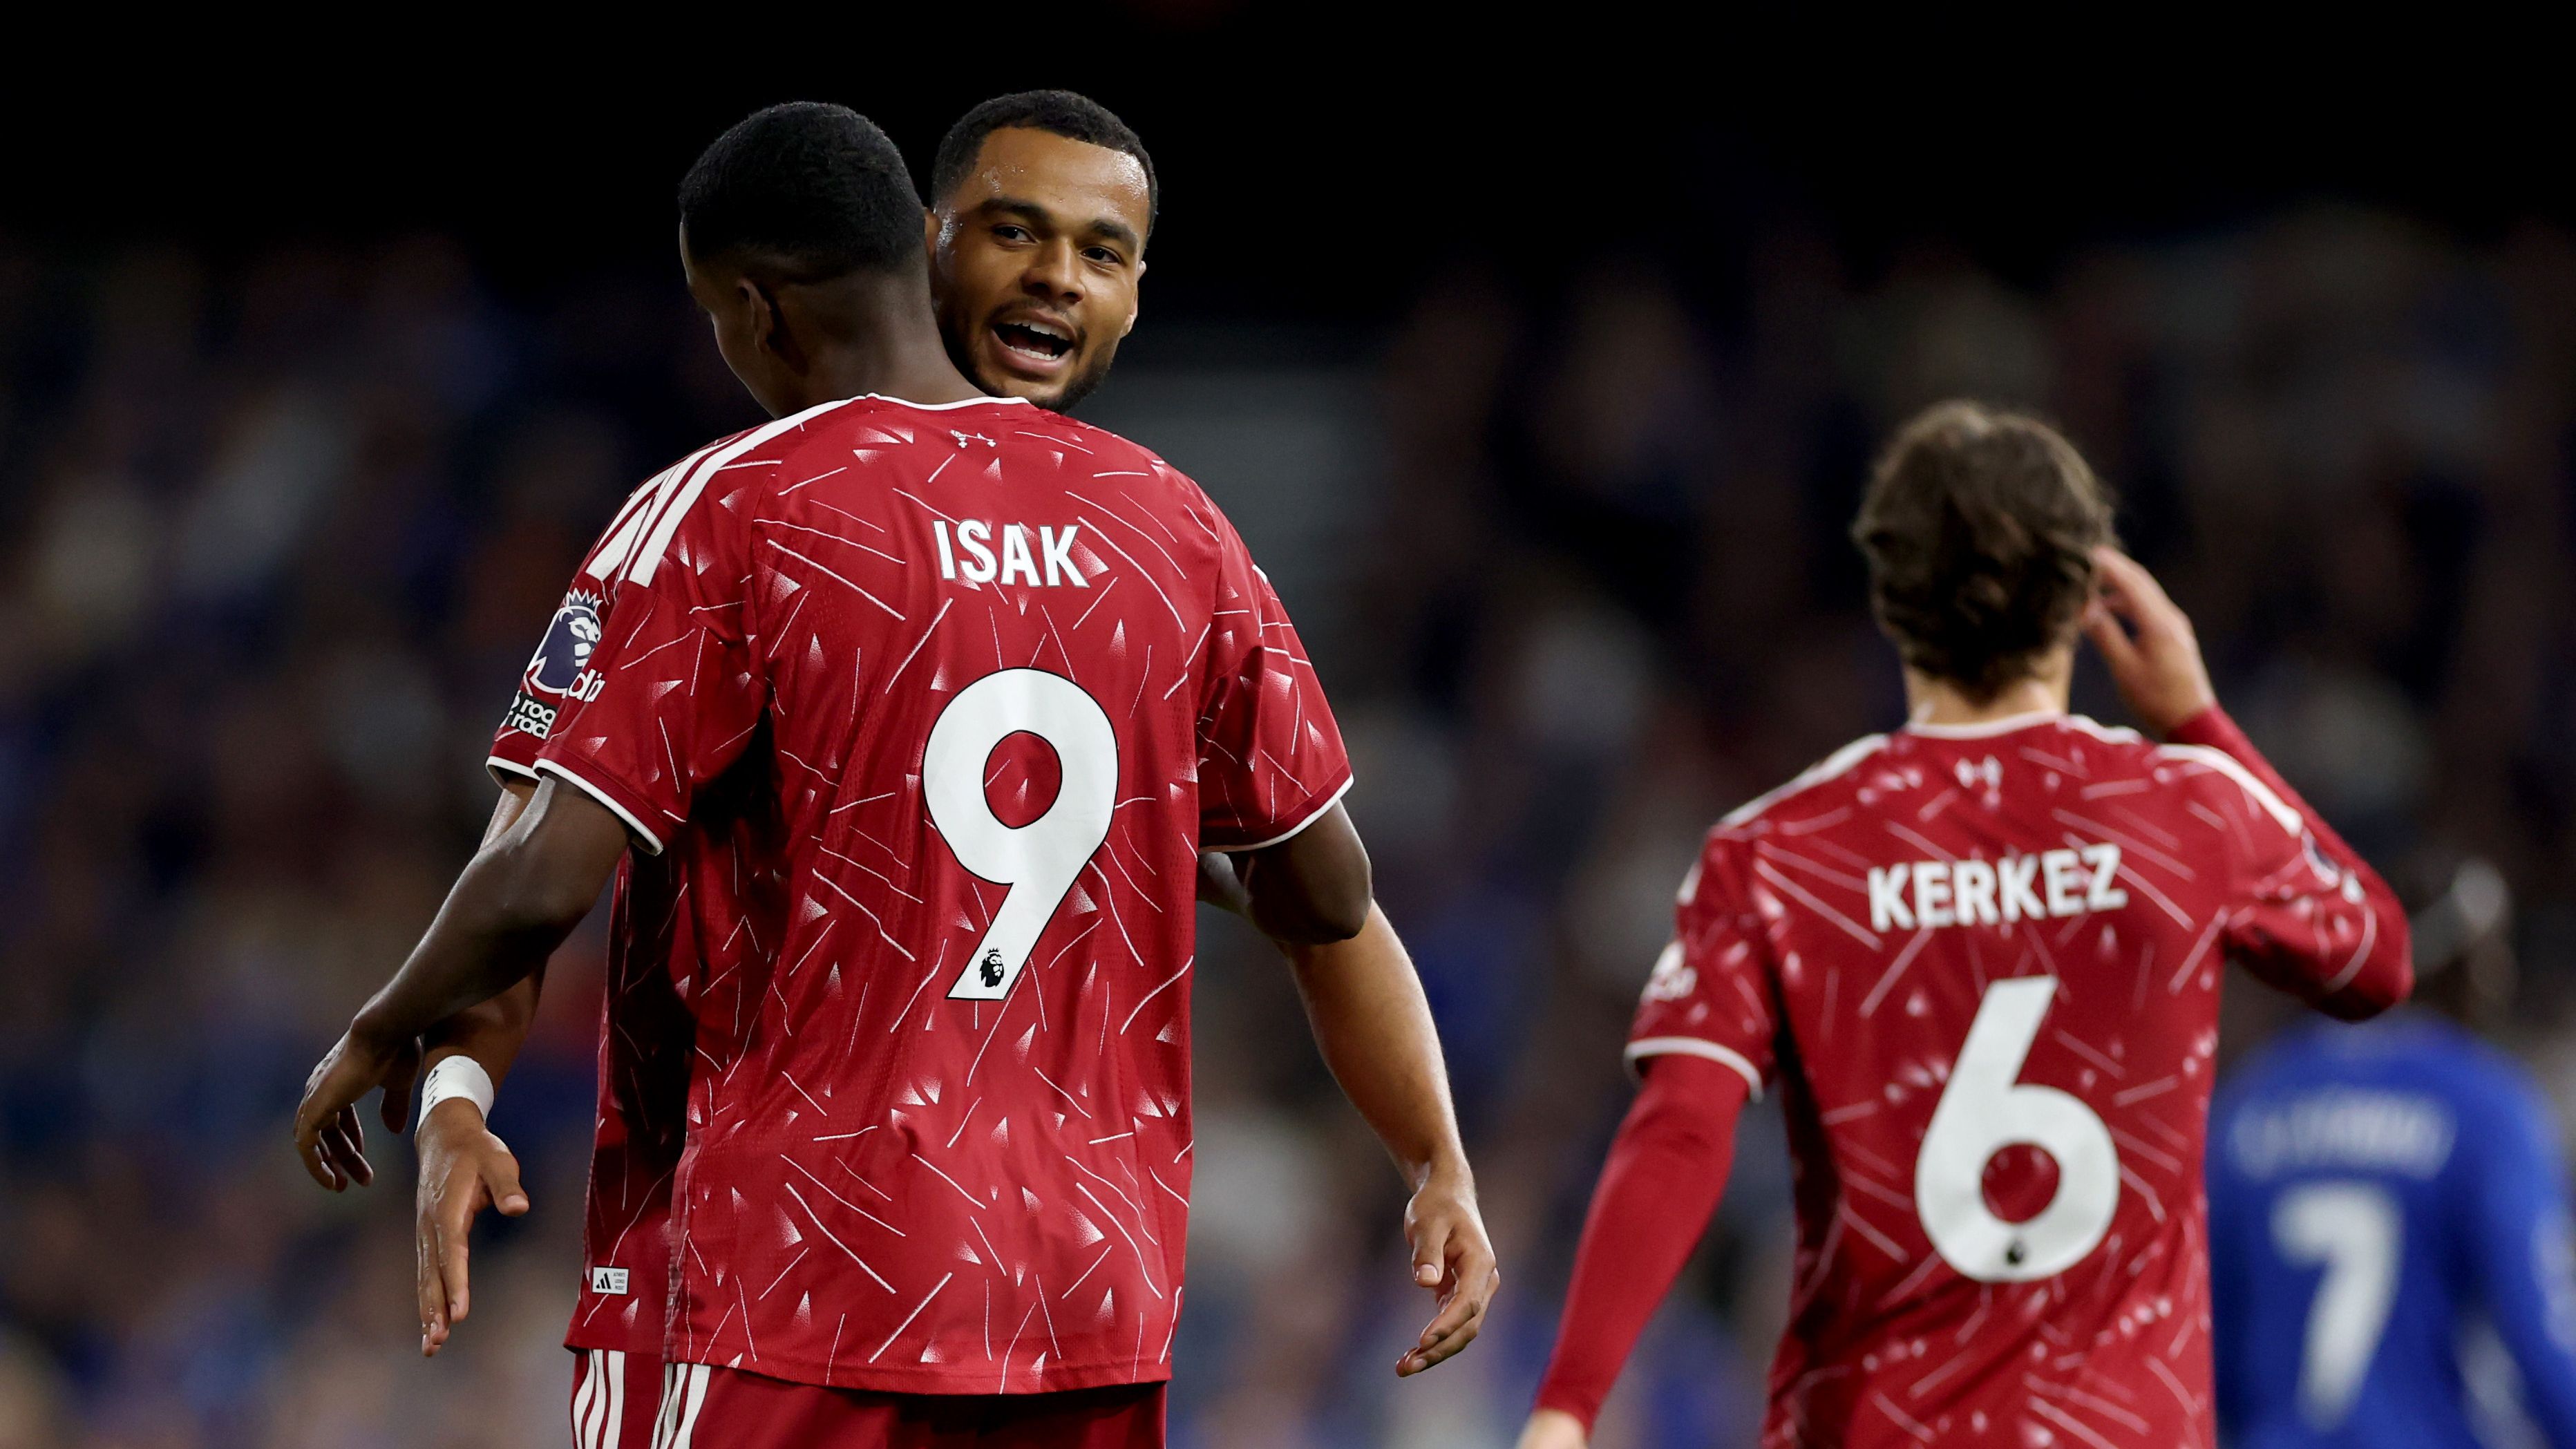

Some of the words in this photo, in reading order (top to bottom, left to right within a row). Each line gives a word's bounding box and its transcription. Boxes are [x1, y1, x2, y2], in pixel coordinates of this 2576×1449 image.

[931, 518, 1090, 589] ISAK
[511, 713, 550, 740] raci
[520, 699, 556, 726] roo
[923, 667, 1119, 1001] 9
[1867, 842, 2129, 932] KERKEZ
[1914, 974, 2121, 1284] 6
[2270, 1178, 2405, 1432] 7
